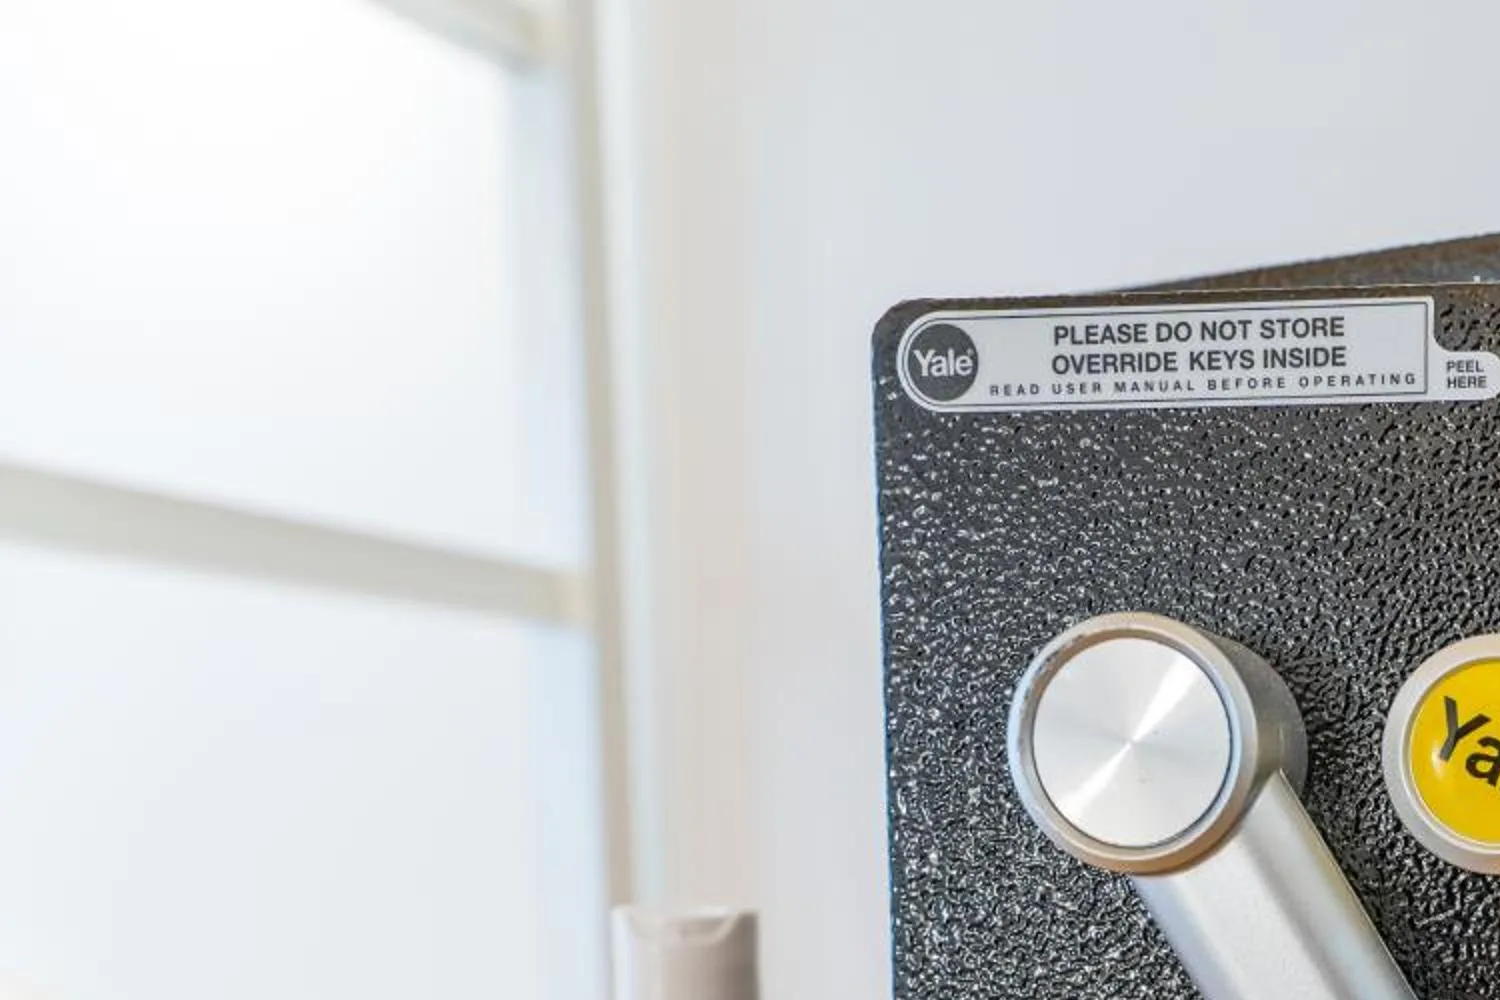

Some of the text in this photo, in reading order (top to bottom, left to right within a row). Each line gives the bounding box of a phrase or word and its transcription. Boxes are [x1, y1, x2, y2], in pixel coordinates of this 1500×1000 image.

[1053, 316, 1346, 346] PLEASE DO NOT STORE
[913, 348, 974, 378] Yale
[1052, 346, 1348, 375] OVERRIDE KEYS INSIDE
[1446, 359, 1485, 374] PEEL
[989, 373, 1417, 397] READ USER MANUAL BEFORE OPERATING
[1446, 375, 1488, 389] HERE
